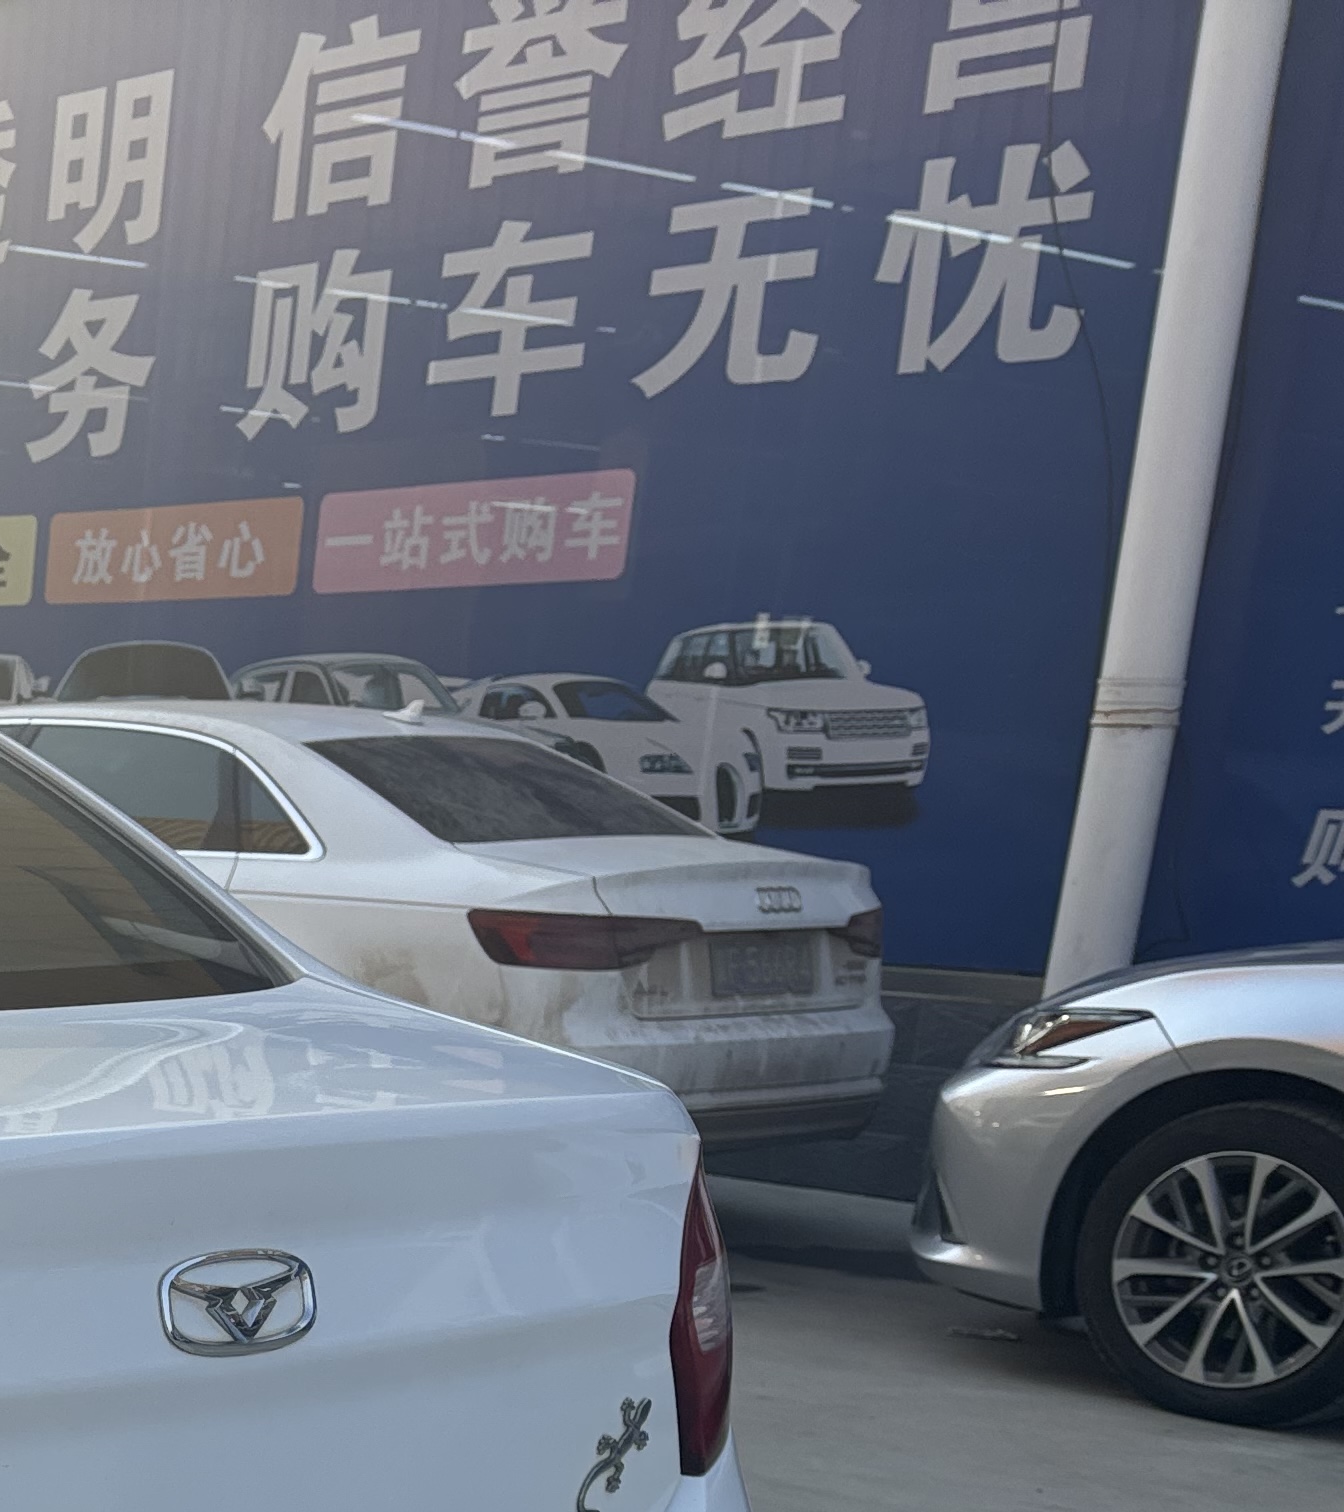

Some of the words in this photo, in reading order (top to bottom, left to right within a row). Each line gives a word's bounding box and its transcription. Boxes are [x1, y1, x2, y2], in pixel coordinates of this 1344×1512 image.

[236, 140, 1095, 441] 购车无忧
[72, 520, 265, 586] 放心省心
[324, 490, 625, 575] 一站式购车
